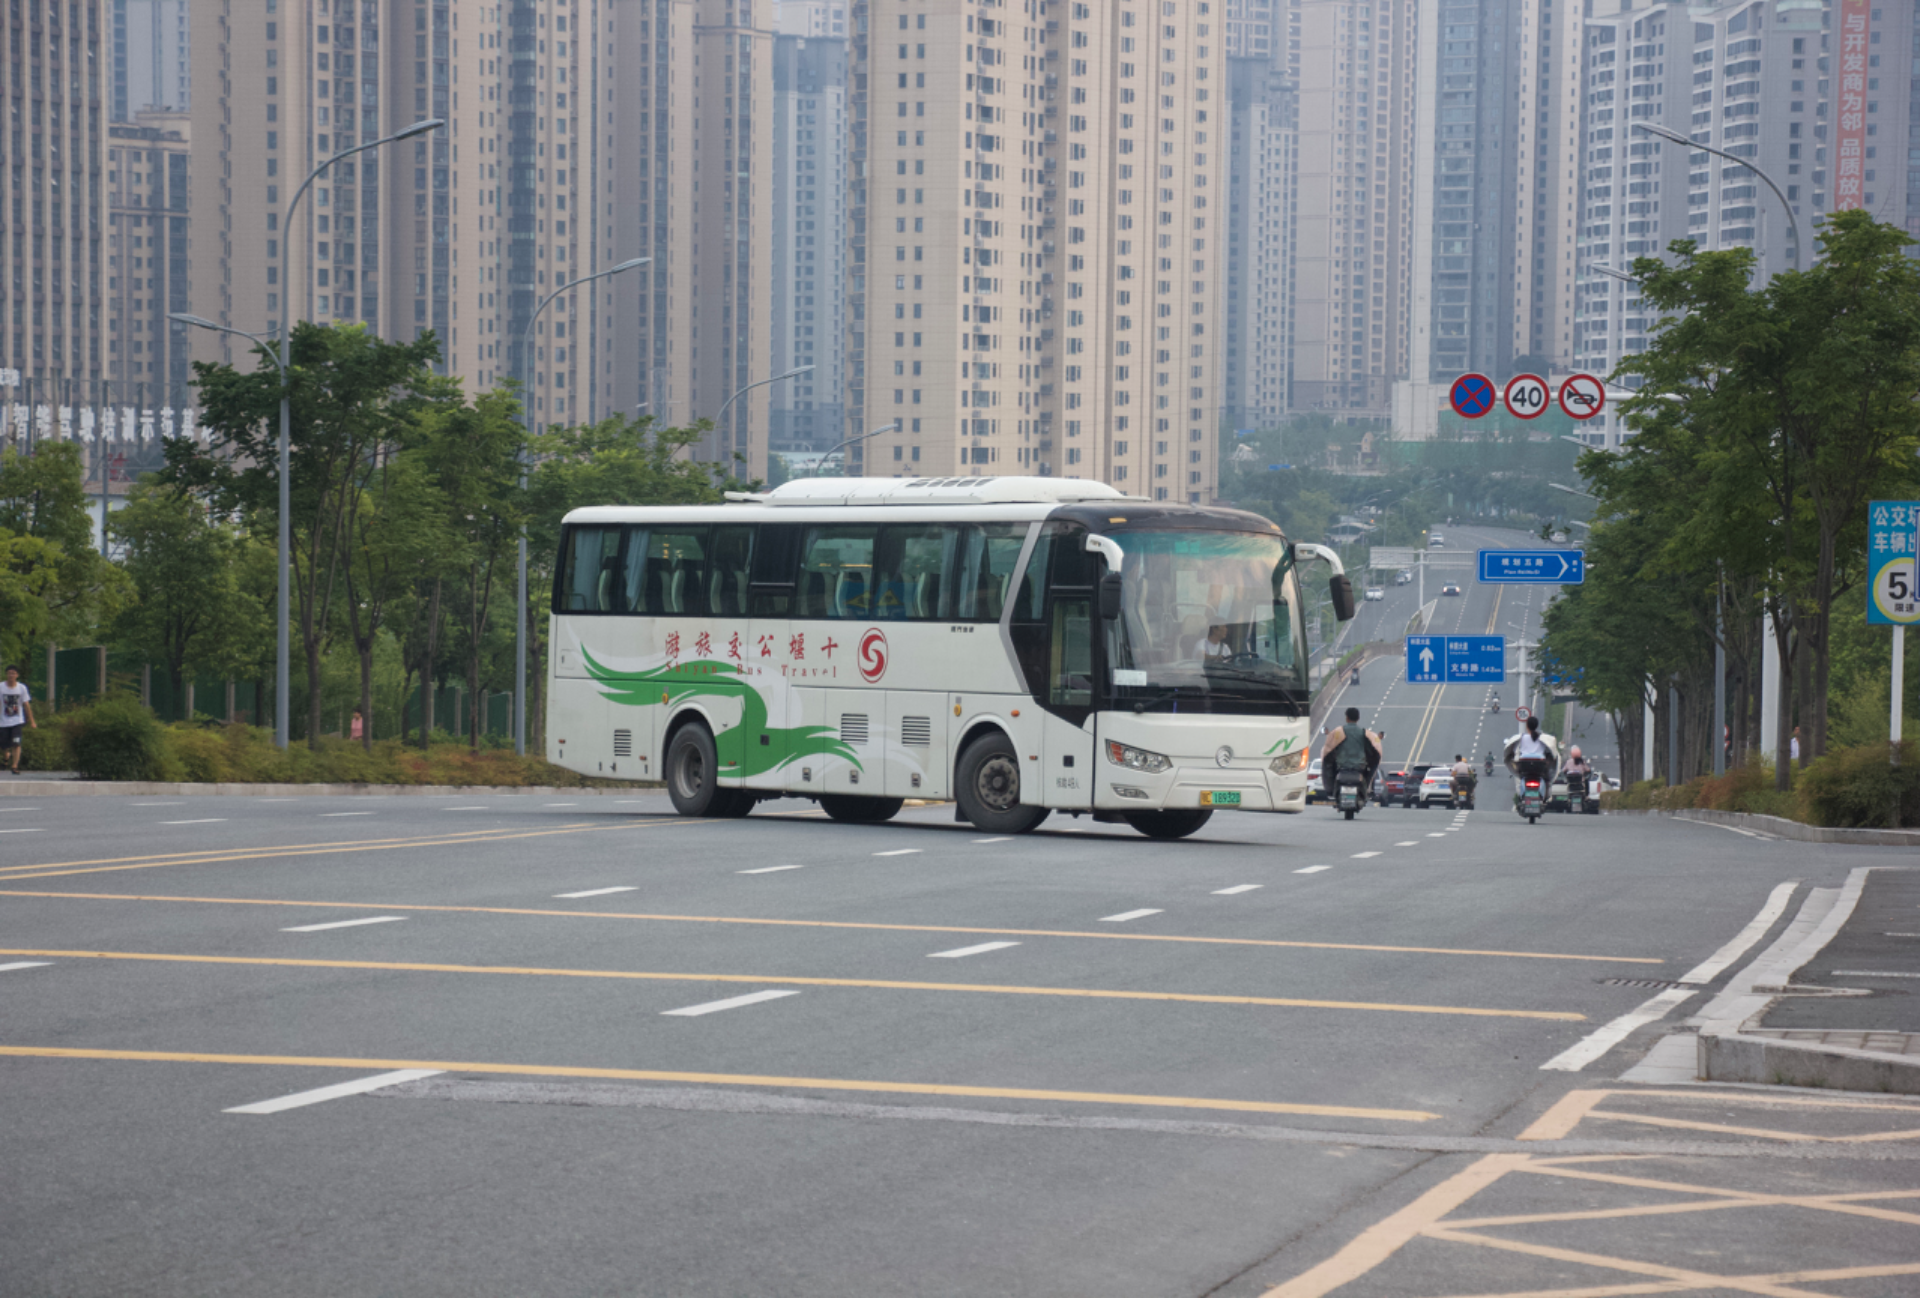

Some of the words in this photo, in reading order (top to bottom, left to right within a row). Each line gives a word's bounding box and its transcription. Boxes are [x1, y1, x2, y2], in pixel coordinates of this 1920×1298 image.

[1841, 13, 1866, 131] 与开发商为邻
[1838, 138, 1861, 213] 品质放心
[1512, 386, 1542, 407] 40
[665, 661, 718, 676] Shiyan
[737, 663, 763, 676] Bus
[781, 665, 837, 678] Travel
